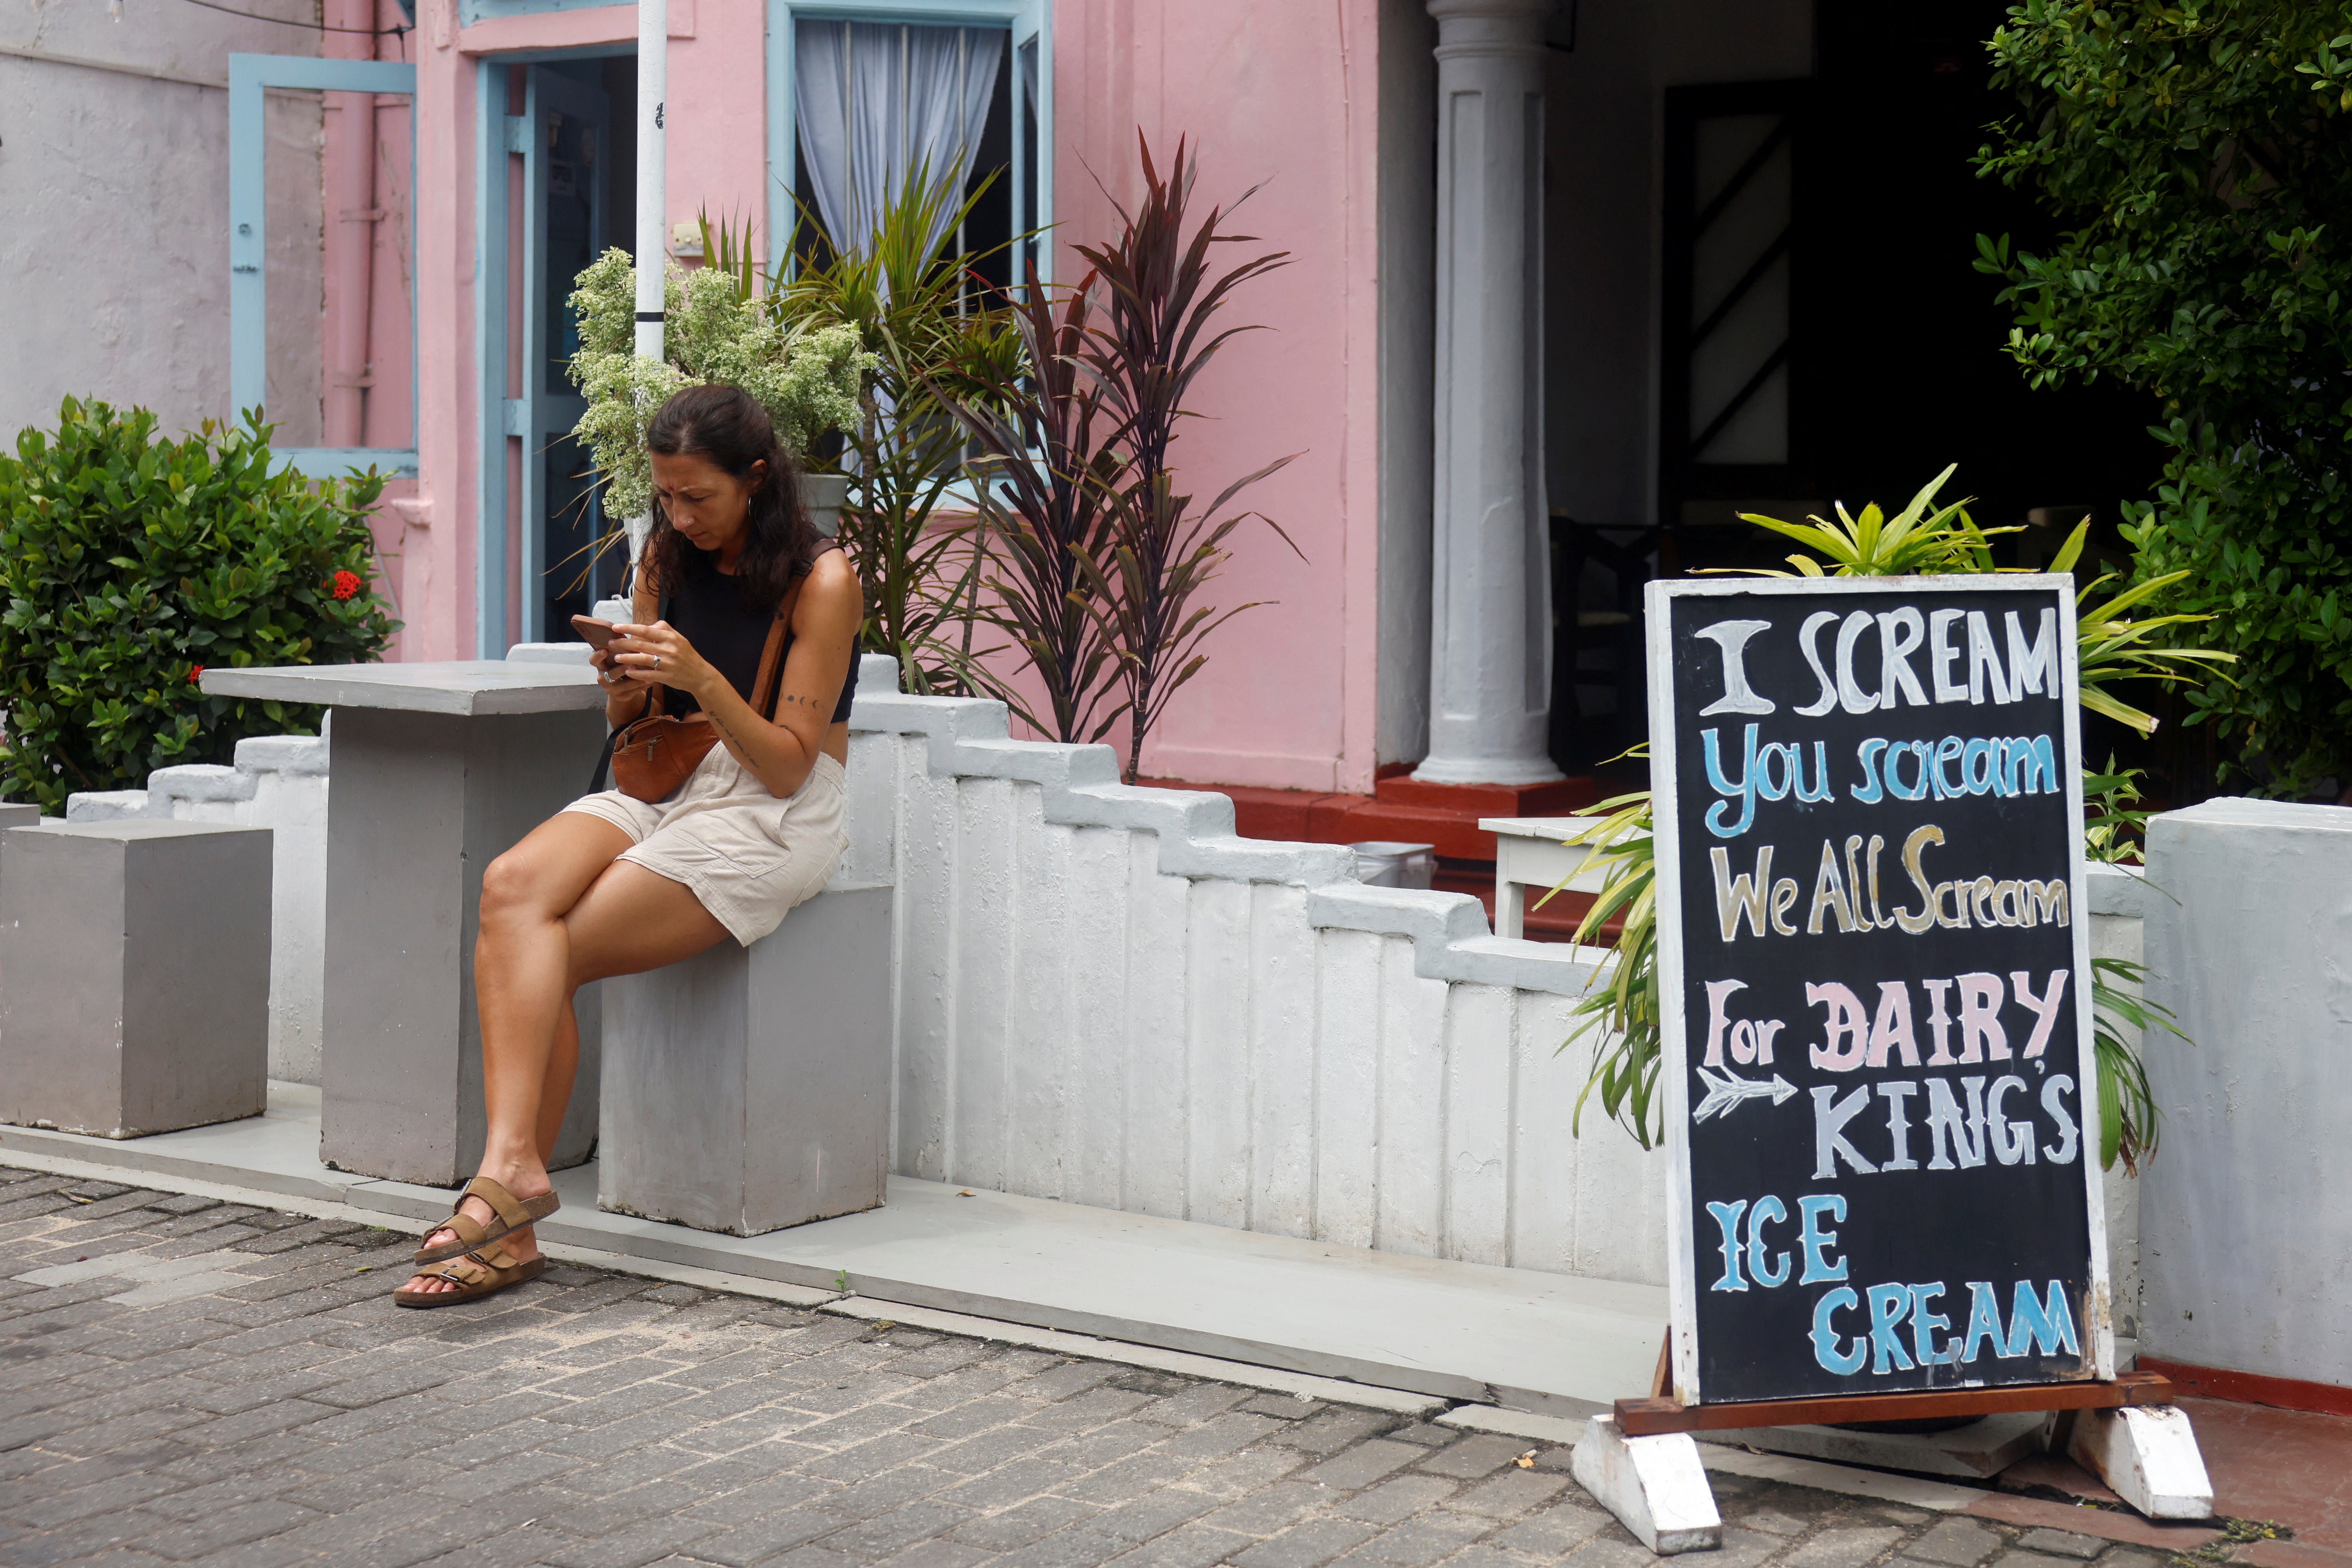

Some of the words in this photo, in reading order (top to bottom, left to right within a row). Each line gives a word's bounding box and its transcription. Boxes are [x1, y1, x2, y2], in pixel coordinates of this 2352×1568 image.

[1694, 619, 1775, 716] I
[1793, 606, 2059, 716] SCREAM
[1850, 733, 2060, 804] scream
[1710, 845, 1798, 943] We
[1807, 834, 1894, 935] All
[1892, 824, 2069, 935] Scream
[1703, 979, 1786, 1068] For
[1805, 968, 2069, 1072] DAIRY
[1705, 1194, 1849, 1293] ICE
[1806, 1279, 2081, 1376] CREAM
